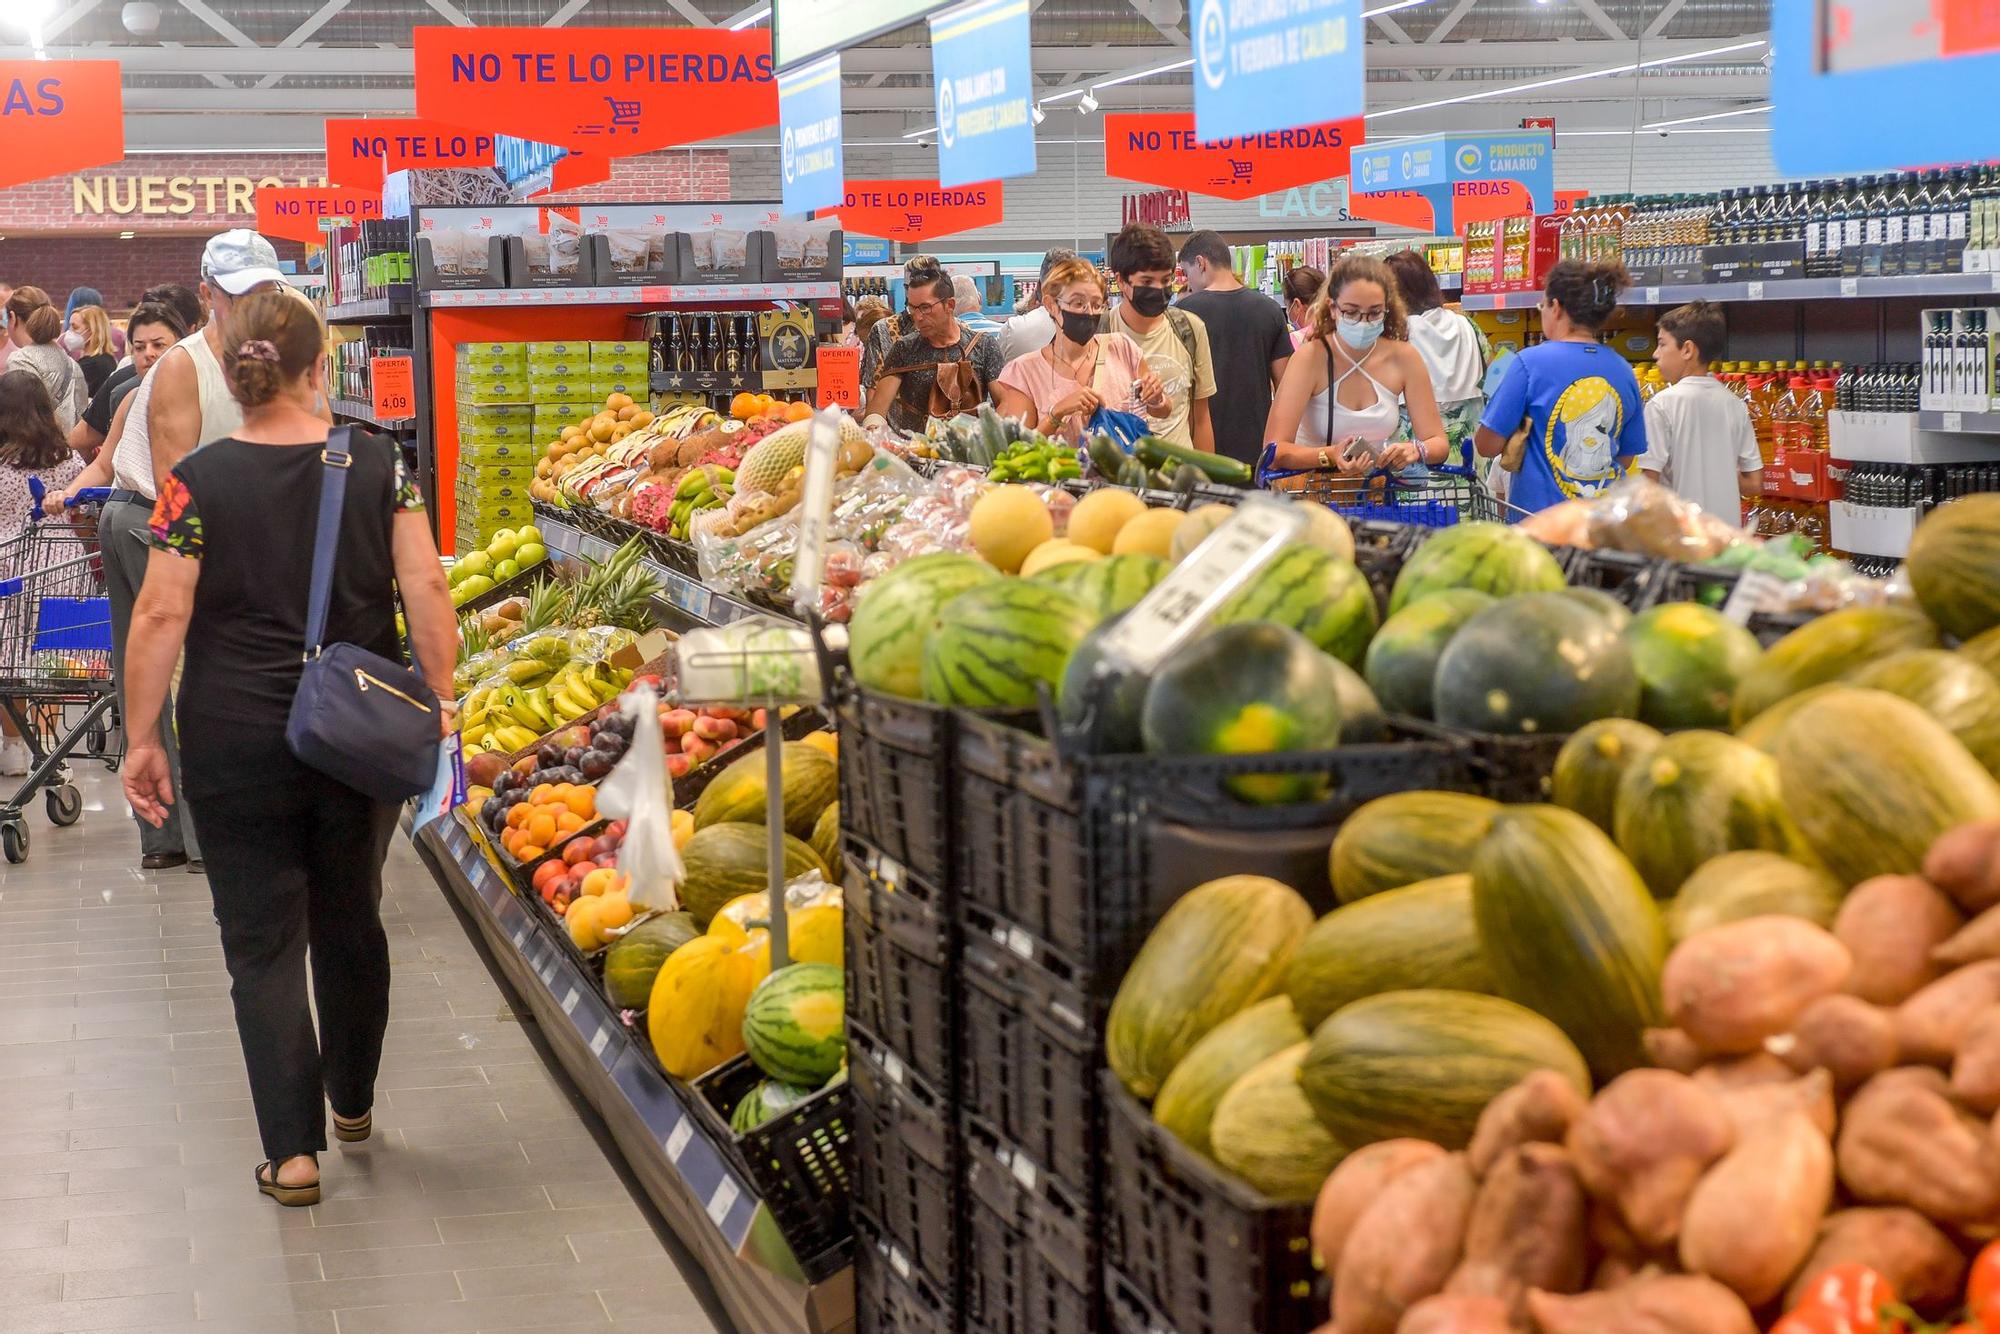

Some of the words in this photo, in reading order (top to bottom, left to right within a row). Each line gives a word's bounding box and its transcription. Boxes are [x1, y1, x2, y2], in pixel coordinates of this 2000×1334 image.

[452, 53, 501, 82] NO
[512, 53, 556, 82] TE
[568, 54, 612, 82] LO
[624, 54, 772, 83] PIERDAS
[352, 137, 388, 158] NO
[395, 137, 426, 158] TE
[436, 137, 467, 158] LO
[1128, 131, 1161, 152] NO
[1168, 131, 1196, 151] TE
[1241, 128, 1342, 150] PIERDAS
[1489, 143, 1545, 159] PRODUCTO
[1489, 157, 1538, 172] CANARIO
[861, 193, 882, 207] TE
[888, 193, 908, 207] LO
[914, 192, 986, 207] PIERDAS
[1139, 190, 1190, 223] BODEGA
[275, 200, 300, 215] NO
[306, 200, 327, 214] TE
[334, 200, 356, 214] LO
[382, 397, 407, 409] 4,09
[826, 390, 849, 402] 3,19
